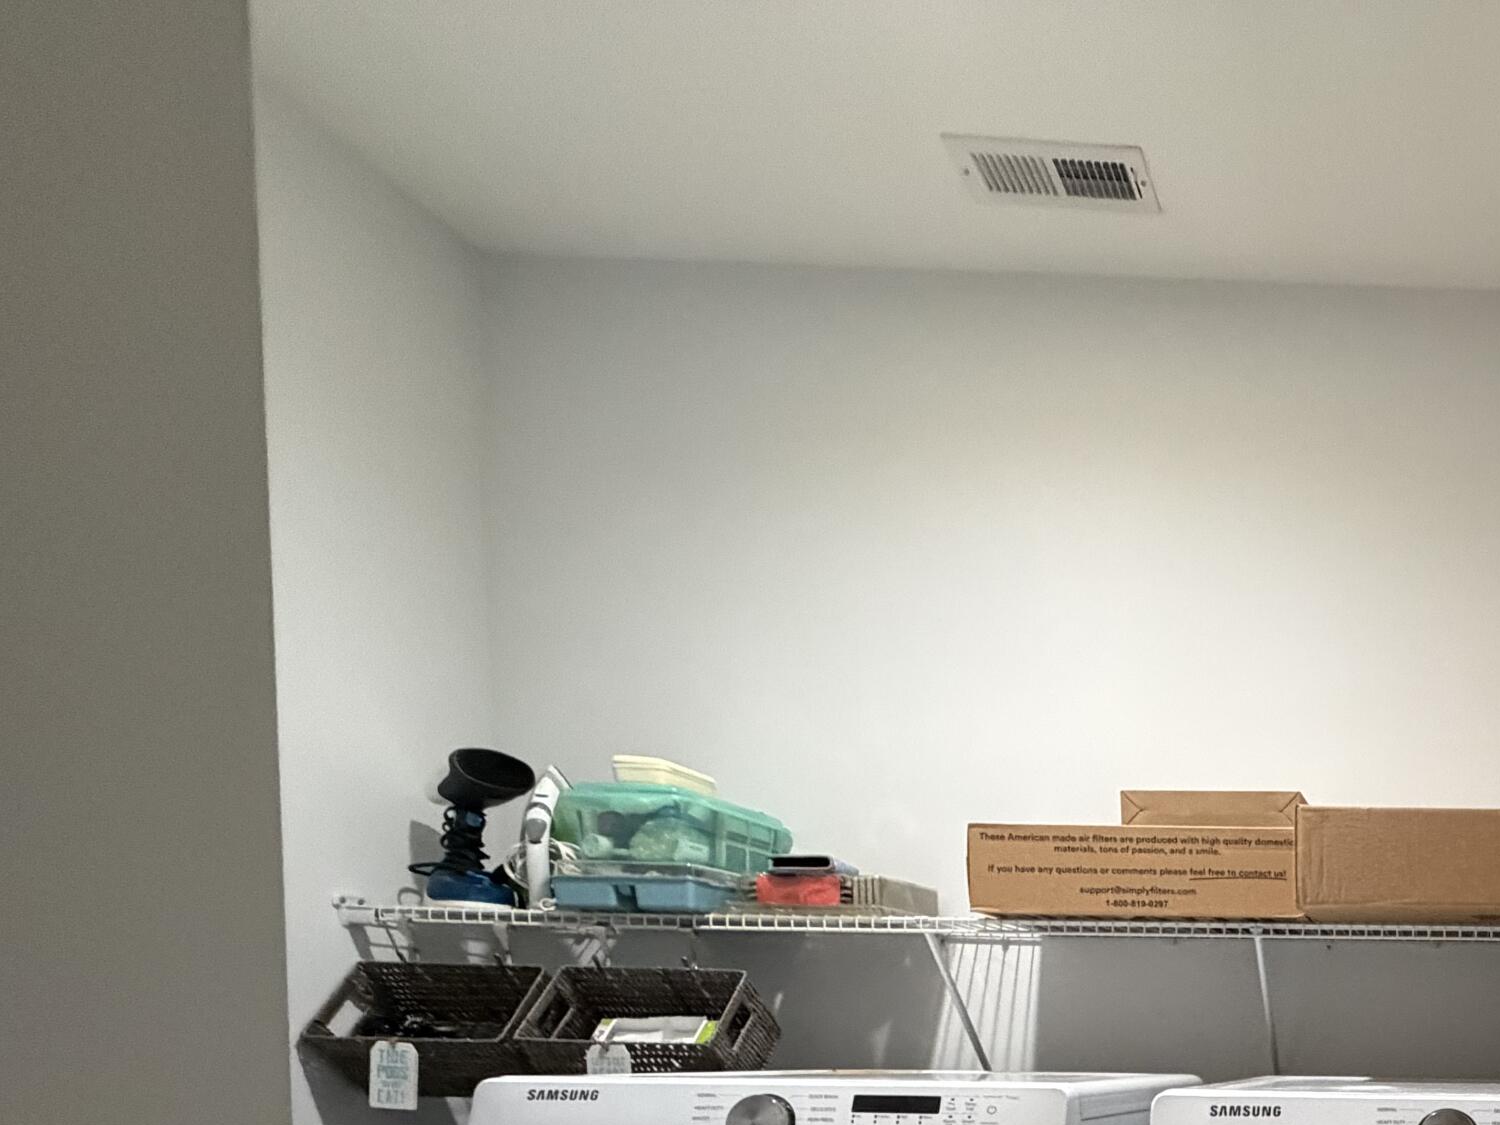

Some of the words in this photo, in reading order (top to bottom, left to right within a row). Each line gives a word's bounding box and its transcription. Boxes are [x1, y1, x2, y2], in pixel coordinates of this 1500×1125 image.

[980, 832, 1005, 841] These
[1008, 833, 1050, 842] American
[1052, 834, 1077, 842] made
[1079, 834, 1090, 842] air
[1092, 834, 1117, 843] filters
[1136, 836, 1178, 845] produced
[1180, 837, 1199, 845] with
[1201, 837, 1220, 846] high
[1222, 837, 1252, 847] quality
[1255, 838, 1293, 846] domestic
[1054, 845, 1097, 853] materials,
[1132, 847, 1167, 855] passion,
[988, 864, 994, 872] If
[1014, 865, 1035, 873] have
[1055, 866, 1098, 874] questions
[1159, 868, 1187, 876] please
[1190, 868, 1205, 876] feel
[1208, 868, 1225, 876] free
[1080, 886, 1196, 895] support@simplyfilters.com
[527, 1089, 599, 1101] SAMSUNG
[1210, 1105, 1282, 1117] SAMSUNG
